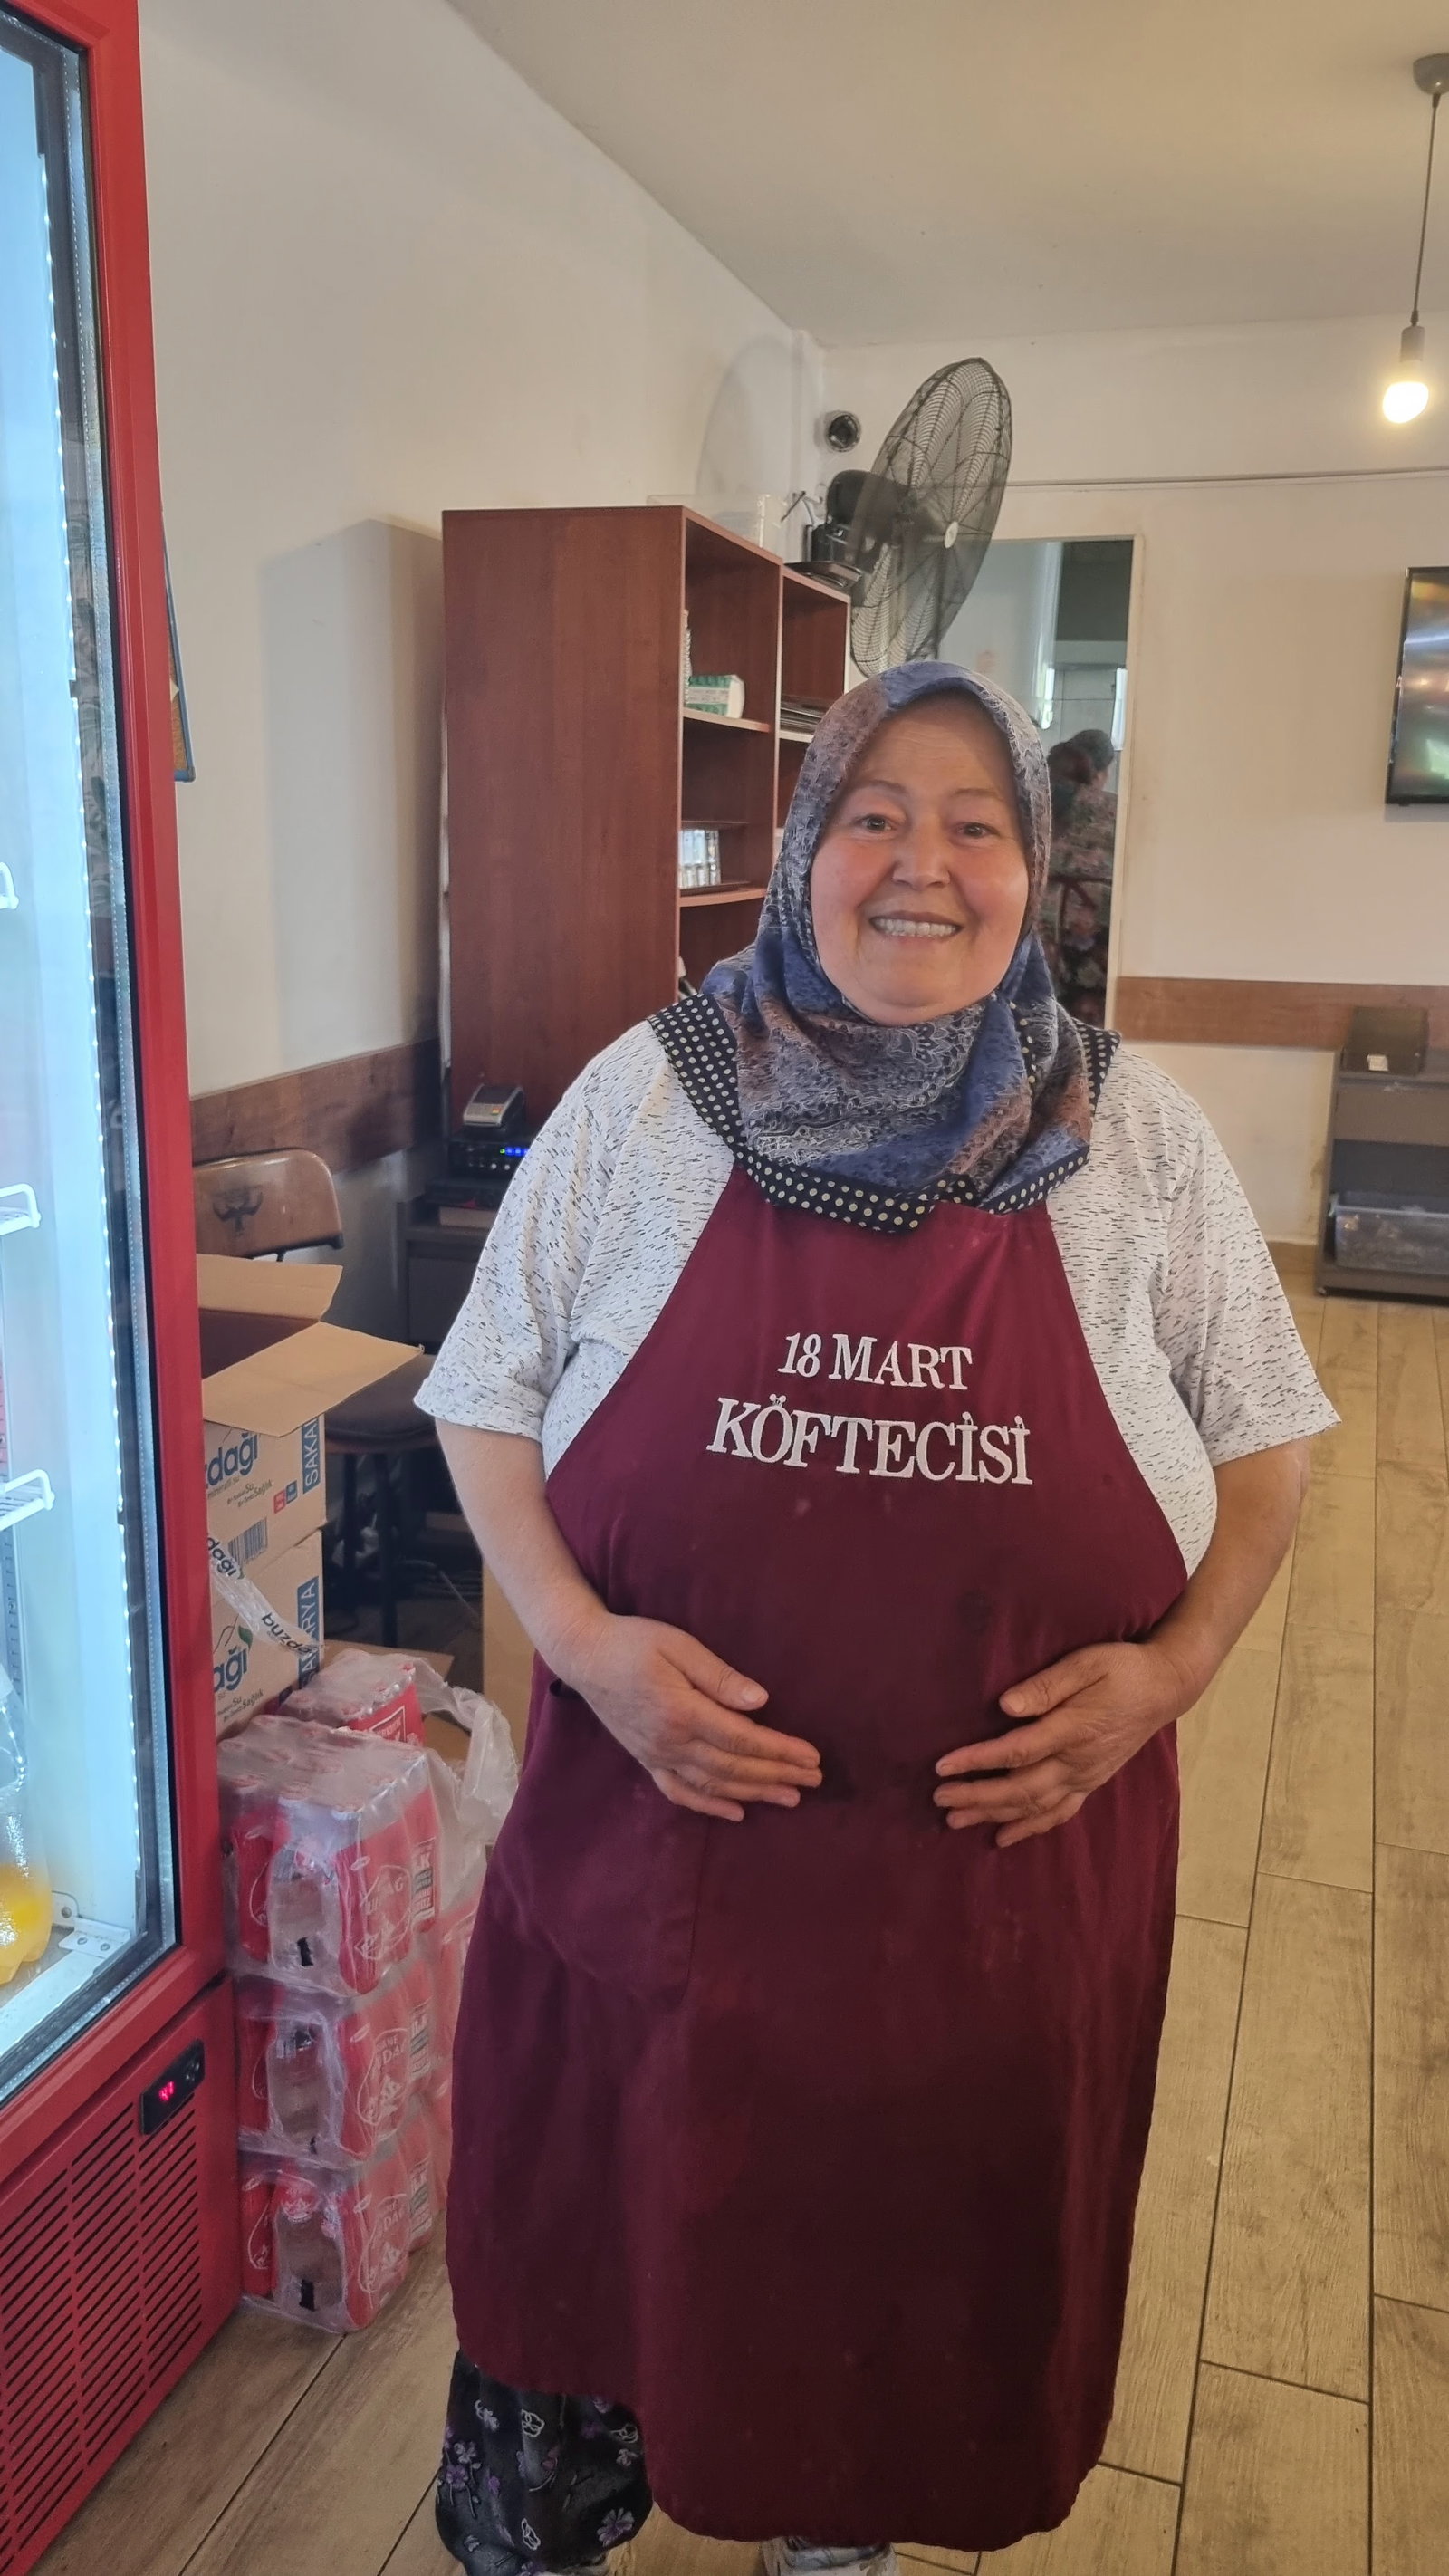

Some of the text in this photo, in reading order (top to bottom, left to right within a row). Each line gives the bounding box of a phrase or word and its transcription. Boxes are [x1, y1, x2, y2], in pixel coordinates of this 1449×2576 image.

[777, 1332, 973, 1390] 18 MART
[705, 1392, 1033, 1485] KÖFTECİSİ
